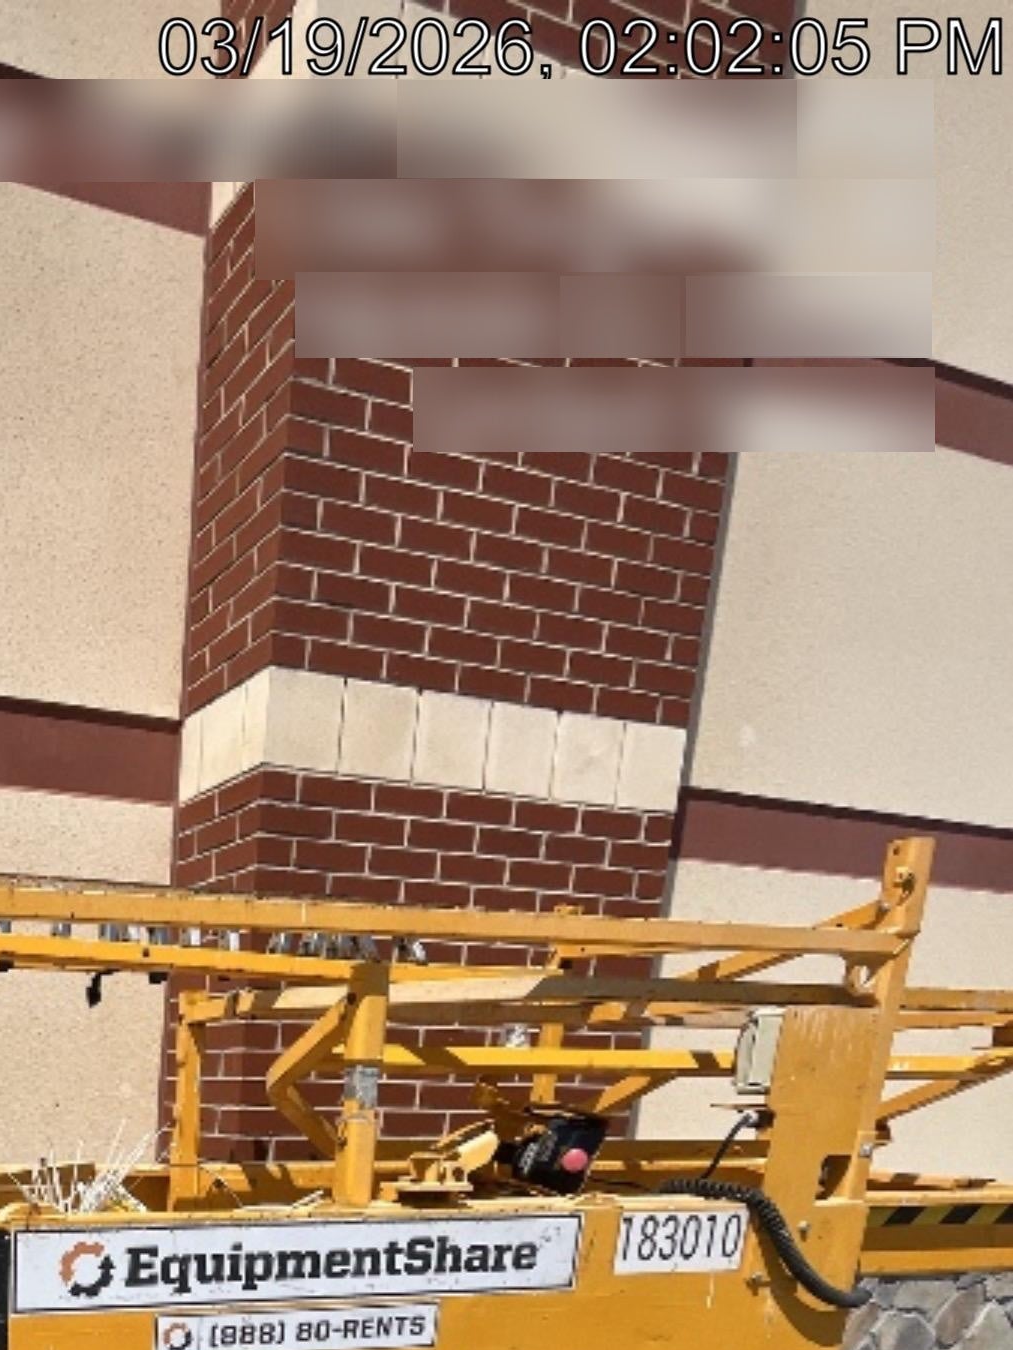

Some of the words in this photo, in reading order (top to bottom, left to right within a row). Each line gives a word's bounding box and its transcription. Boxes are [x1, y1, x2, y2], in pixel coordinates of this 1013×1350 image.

[622, 1214, 742, 1261] 183010
[124, 1236, 537, 1294] EquipmentShare
[209, 1323, 285, 1348] (888)
[296, 1316, 426, 1343] 80-RENTS
